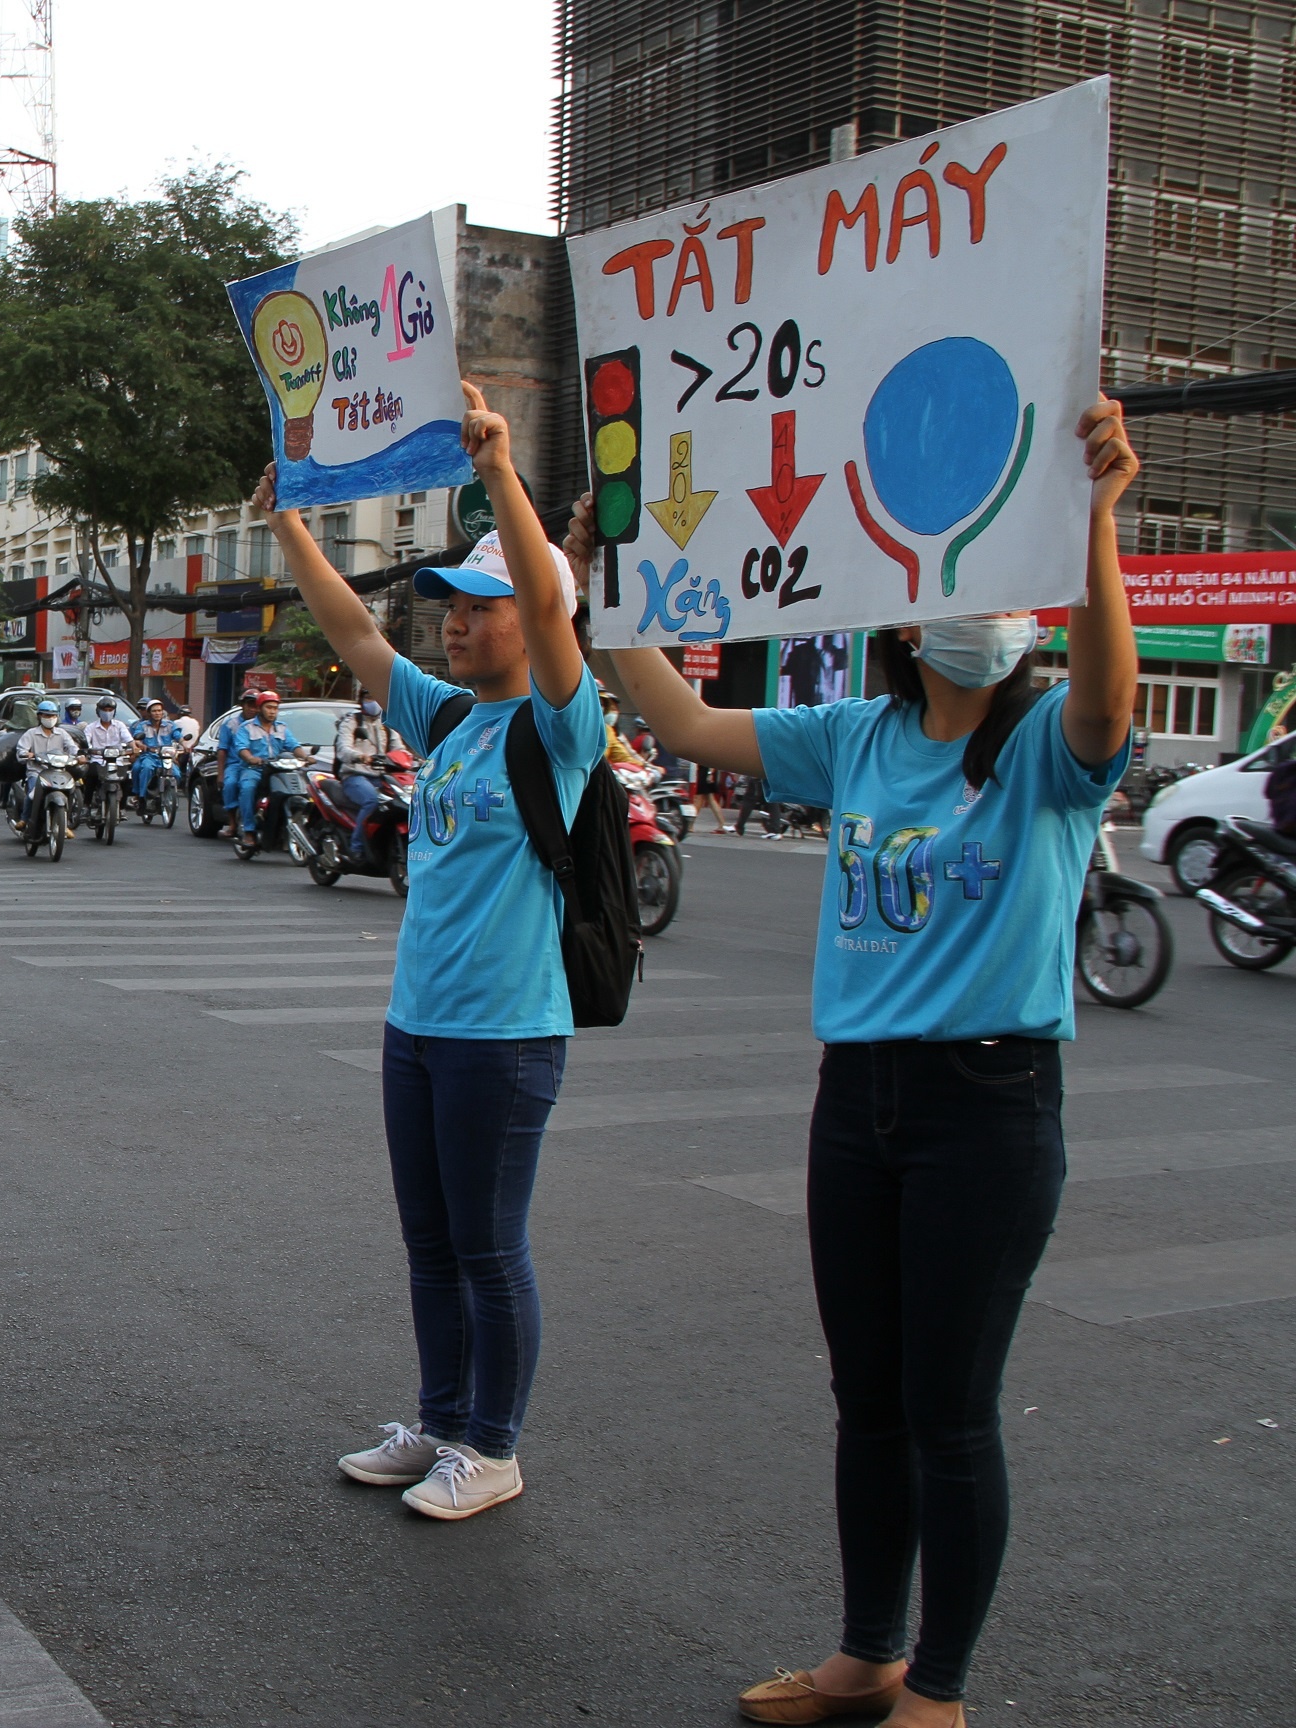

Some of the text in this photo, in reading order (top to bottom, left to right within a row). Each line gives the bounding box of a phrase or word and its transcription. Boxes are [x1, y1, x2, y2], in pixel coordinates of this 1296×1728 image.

[602, 142, 1007, 320] TẮT MÁY
[323, 285, 380, 336] Không
[380, 264, 415, 362] 1
[331, 386, 403, 434] Tắt điện
[1176, 570, 1219, 589] NIỆM
[1221, 572, 1243, 586] 84
[1244, 569, 1286, 585] NĂM
[1228, 591, 1276, 605] MINH
[870, 936, 898, 954] ĐẤT
